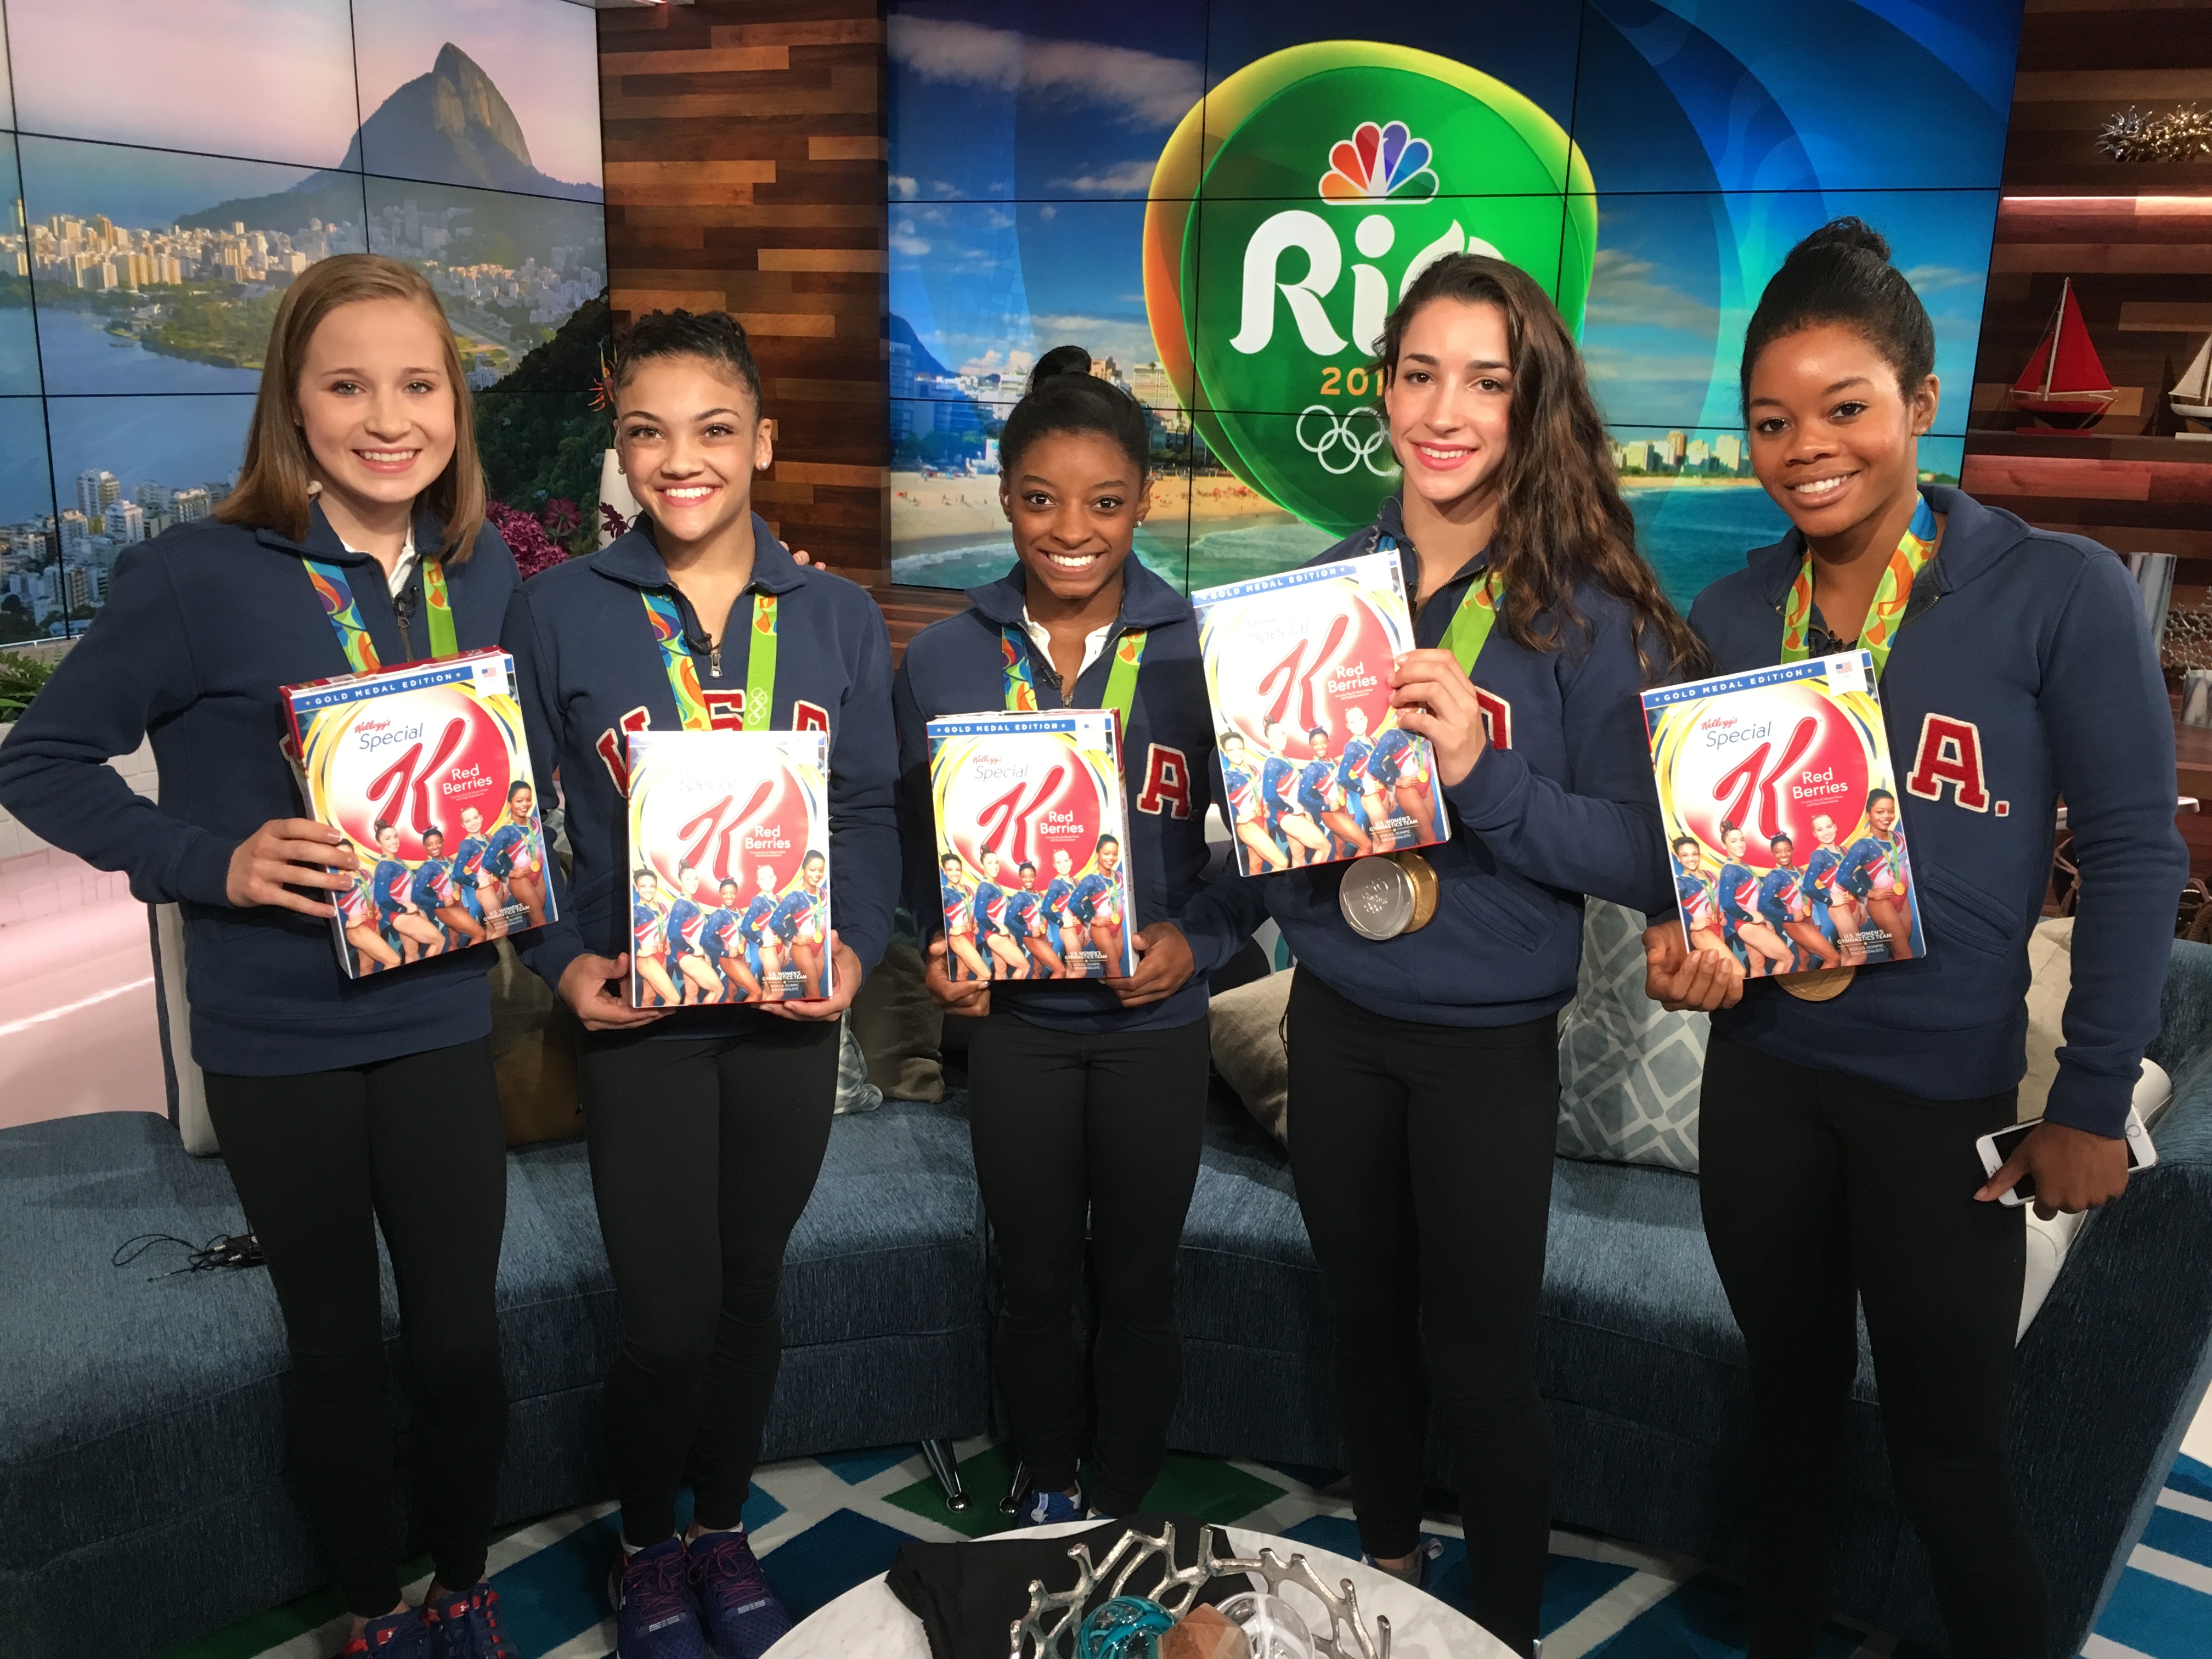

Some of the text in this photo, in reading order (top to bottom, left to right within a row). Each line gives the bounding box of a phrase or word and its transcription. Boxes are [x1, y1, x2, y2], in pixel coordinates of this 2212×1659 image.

[1320, 366, 1384, 396] 201
[1210, 568, 1336, 600] GOLD MEDAL EDITION
[1256, 613, 1350, 733] K
[1336, 661, 1364, 679] Red
[315, 673, 452, 705] GOLD MEDAL EDITION
[1328, 675, 1378, 693] Berries
[1663, 669, 1803, 701] GOLD MEDAL EDITION
[354, 719, 391, 733] Kellogg's
[1701, 716, 1738, 731] Kellogg's
[359, 722, 424, 753] Special
[1706, 721, 1771, 751] Special
[452, 763, 480, 781] Red
[974, 764, 1029, 782] Special
[1906, 713, 2010, 817] A.
[366, 717, 466, 835] K
[1712, 716, 1818, 840] K
[1802, 766, 1833, 785] Red
[443, 776, 493, 795] Berries
[1792, 781, 1848, 799] Berries
[977, 765, 1065, 866] K
[1048, 810, 1073, 822] Red
[1385, 816, 1410, 824] WOMEN'S
[677, 778, 774, 882] K
[755, 825, 781, 837] Red
[1040, 822, 1084, 834] Berries
[1369, 822, 1403, 832] GYMNASTICS
[745, 837, 791, 849] Berries
[1837, 935, 1875, 945] GYMNASTICS
[1855, 929, 1884, 938] WOMEN'S
